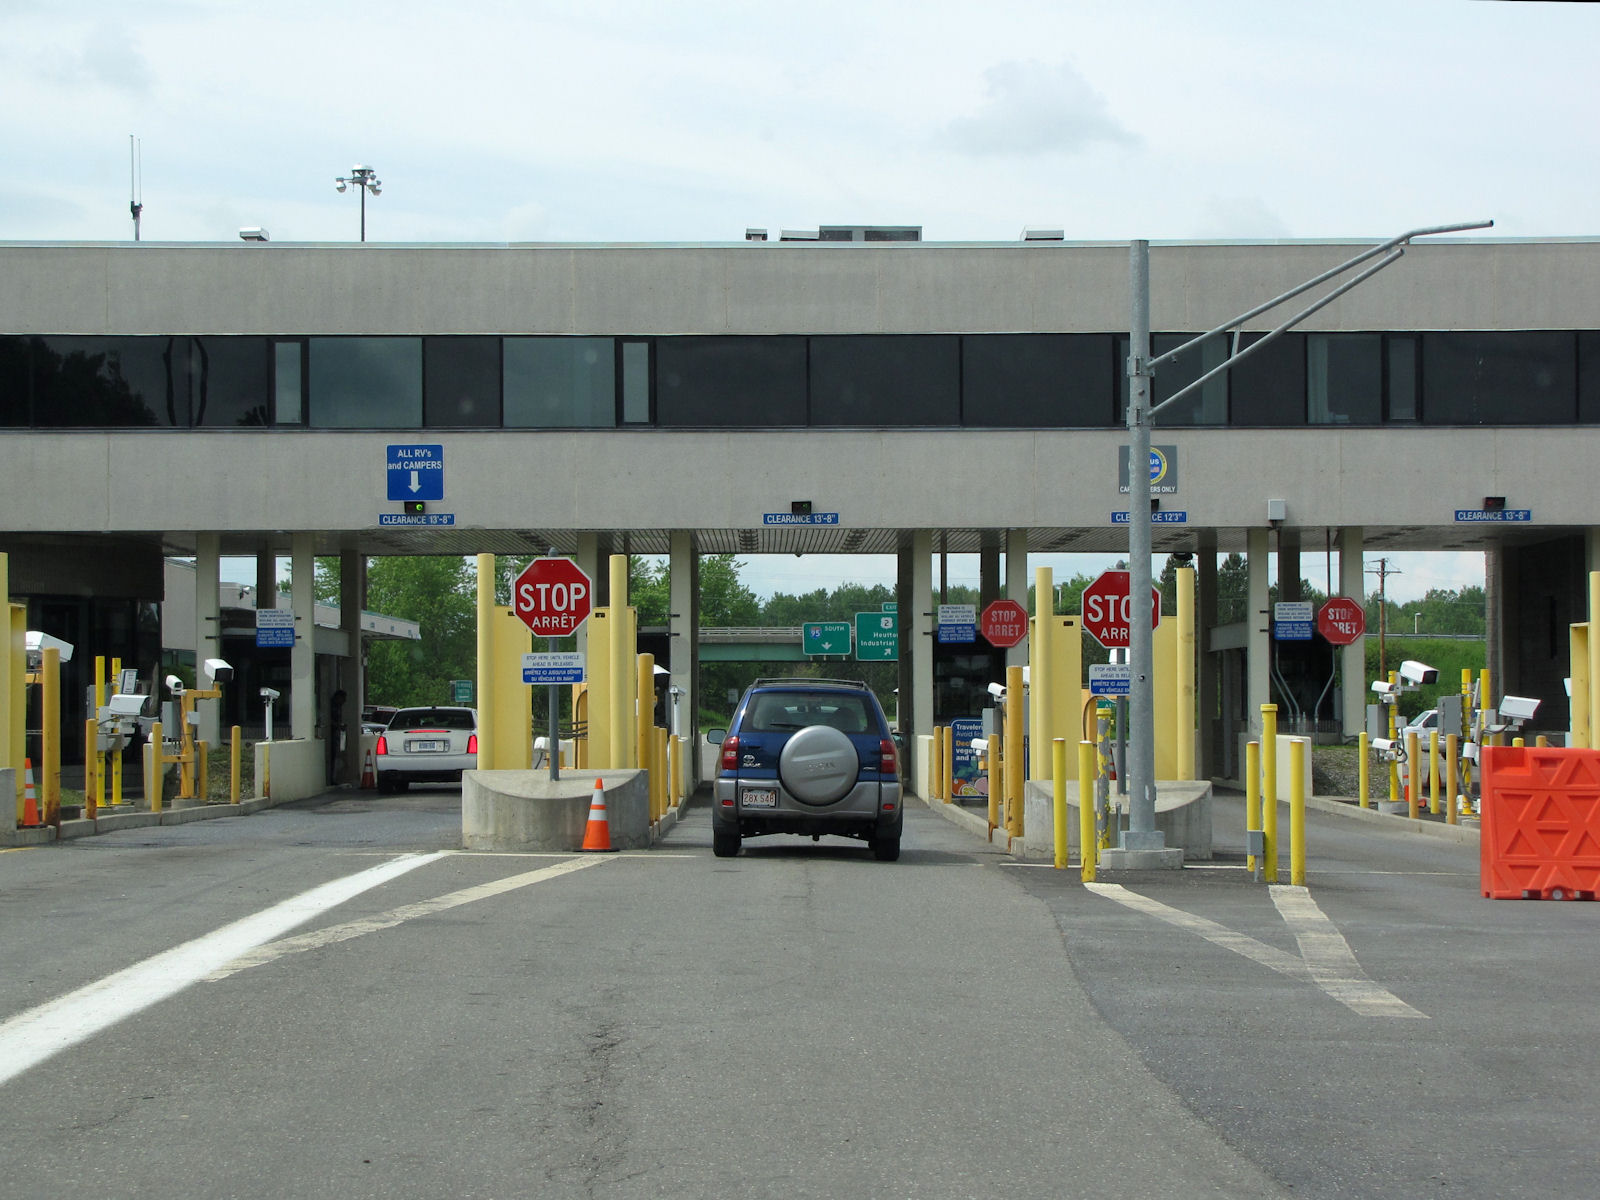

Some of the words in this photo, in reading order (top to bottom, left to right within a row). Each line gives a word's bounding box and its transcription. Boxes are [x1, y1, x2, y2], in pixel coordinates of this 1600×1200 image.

[397, 449, 413, 458] ALL
[414, 449, 432, 458] RV's
[387, 461, 402, 470] and
[403, 461, 442, 470] CAMPERS
[382, 515, 427, 524] CLEARANCE
[767, 515, 811, 523] CLEARANCE
[1115, 513, 1163, 521] CLECE
[1458, 511, 1502, 520] CLEARANCE
[519, 583, 586, 612] STOP
[1087, 594, 1155, 623] STO
[1328, 608, 1353, 620] STOP
[531, 613, 577, 628] ARRÊT
[991, 610, 1017, 623] STOP
[988, 624, 1021, 637] ARRET
[1099, 627, 1129, 640] ARR
